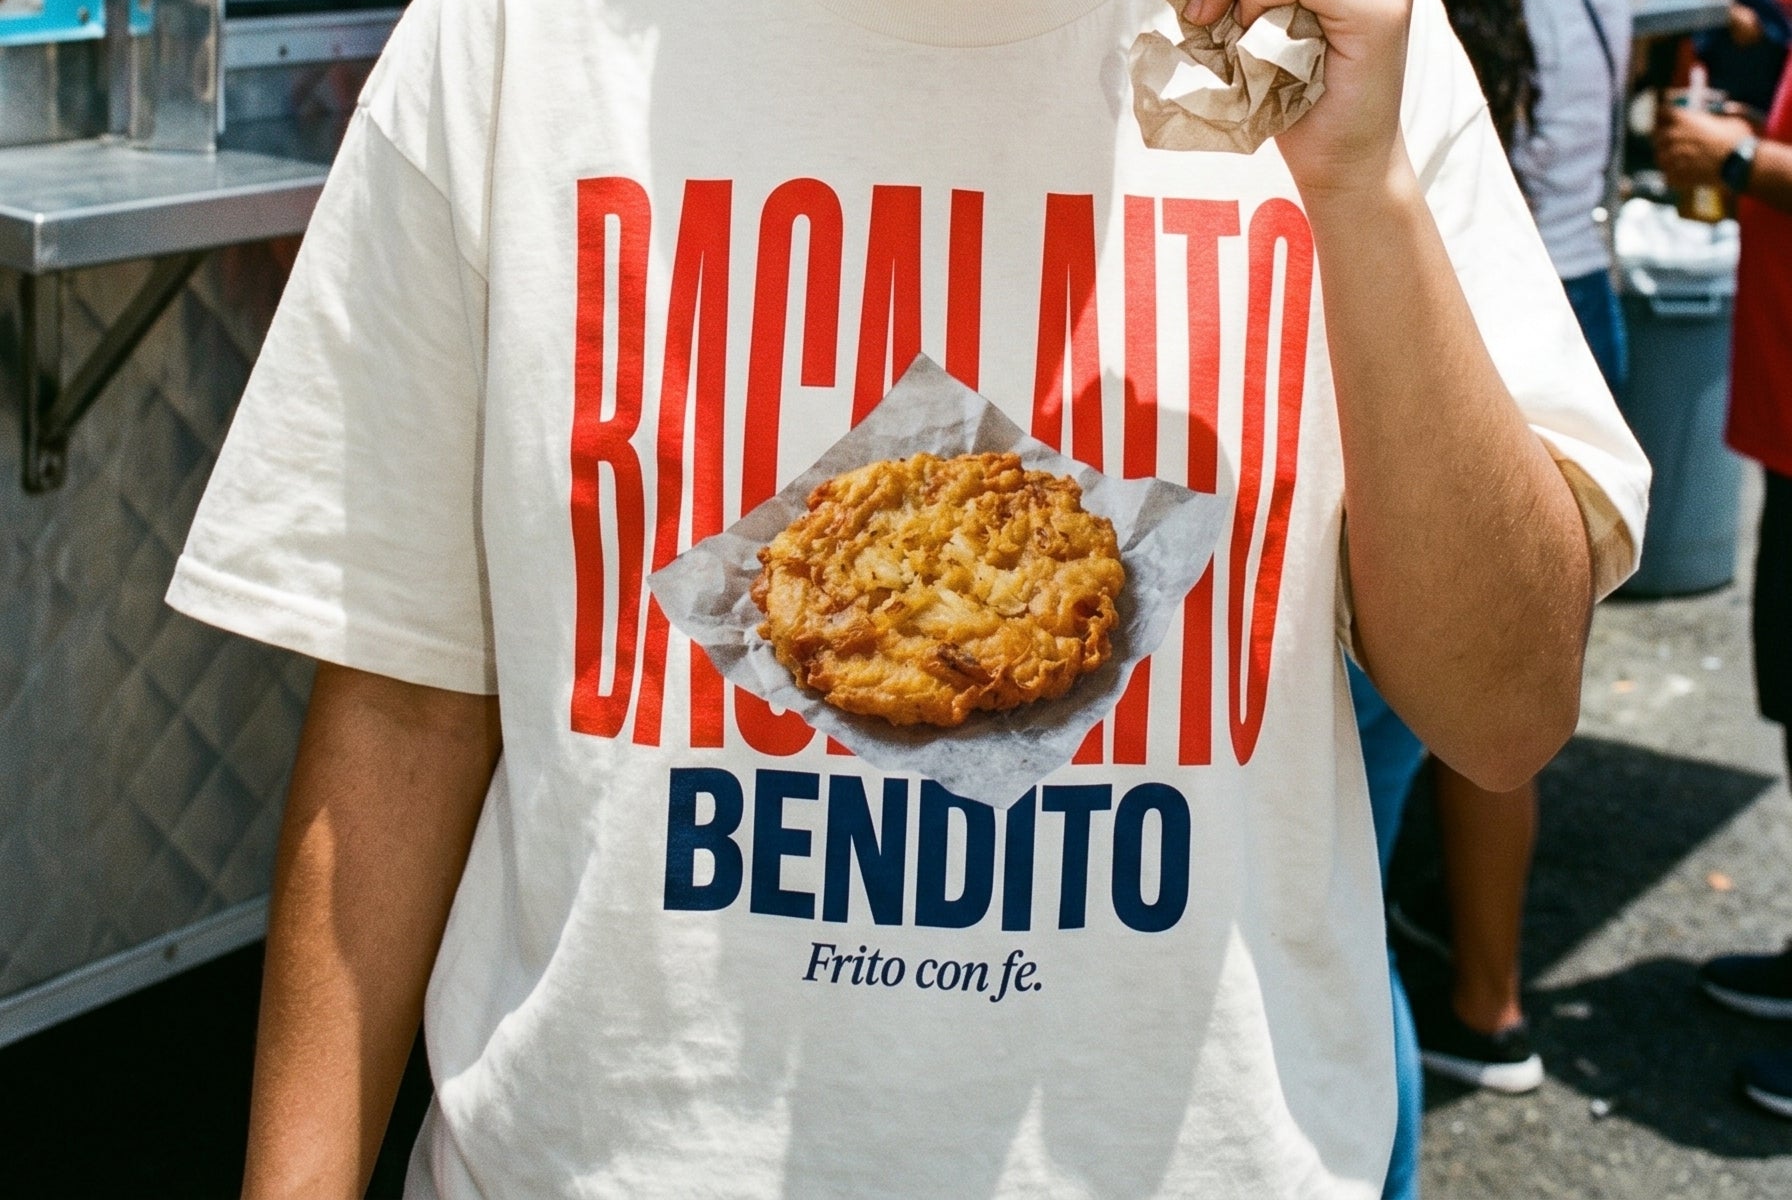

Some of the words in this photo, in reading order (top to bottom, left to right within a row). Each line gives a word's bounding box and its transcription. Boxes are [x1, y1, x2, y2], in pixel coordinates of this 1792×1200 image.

[663, 767, 1191, 933] BENDITO
[802, 942, 906, 987] Frito
[915, 957, 989, 992] con
[989, 949, 1043, 1003] fe.
